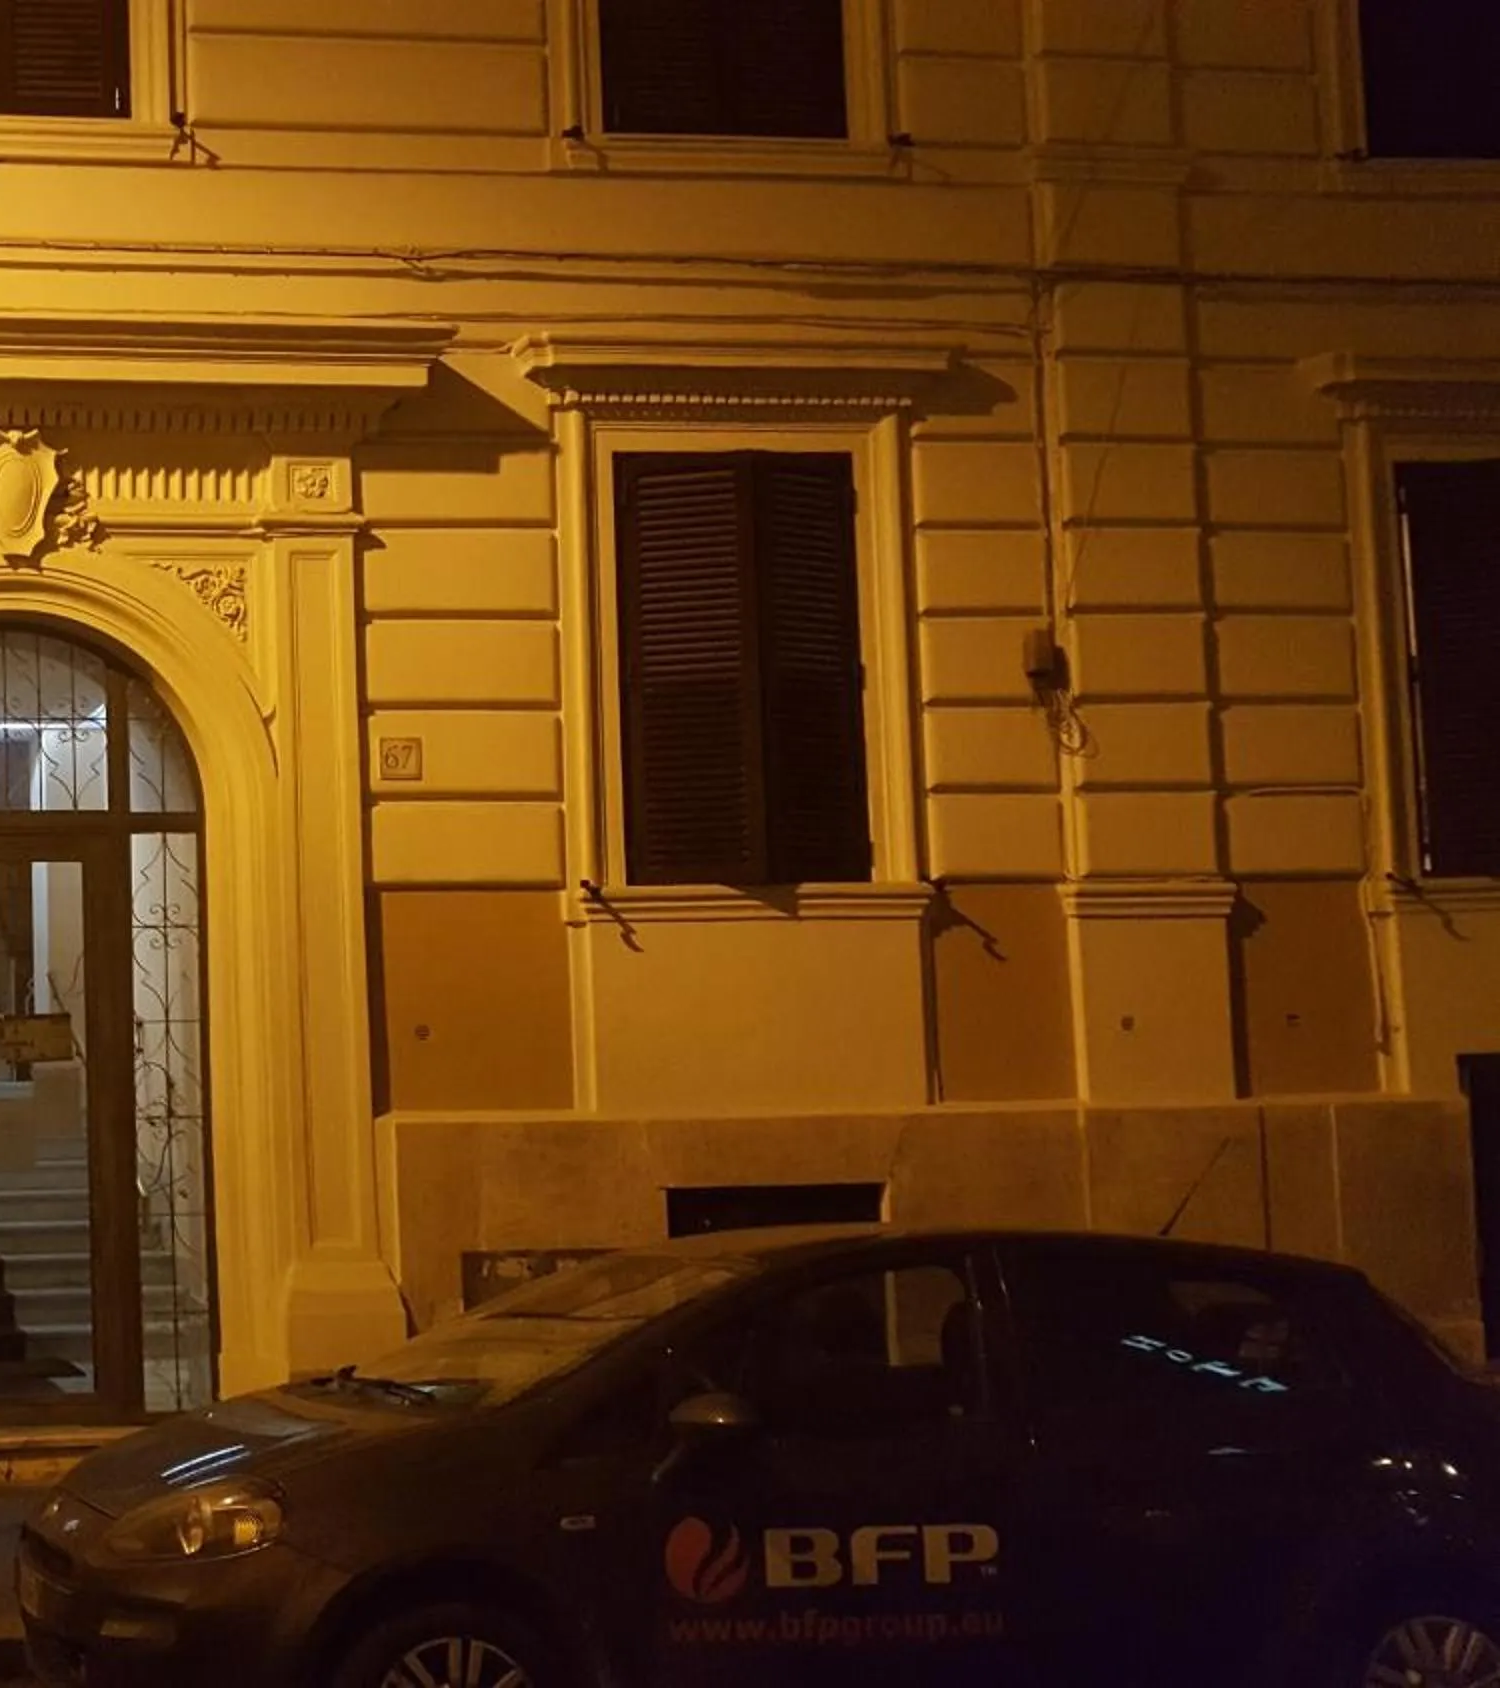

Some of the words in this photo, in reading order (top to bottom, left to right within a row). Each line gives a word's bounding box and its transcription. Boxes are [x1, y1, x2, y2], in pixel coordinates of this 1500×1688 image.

[385, 744, 413, 769] 67
[763, 1523, 999, 1588] BFP
[668, 1610, 1003, 1646] www.bfpgroup.eu
